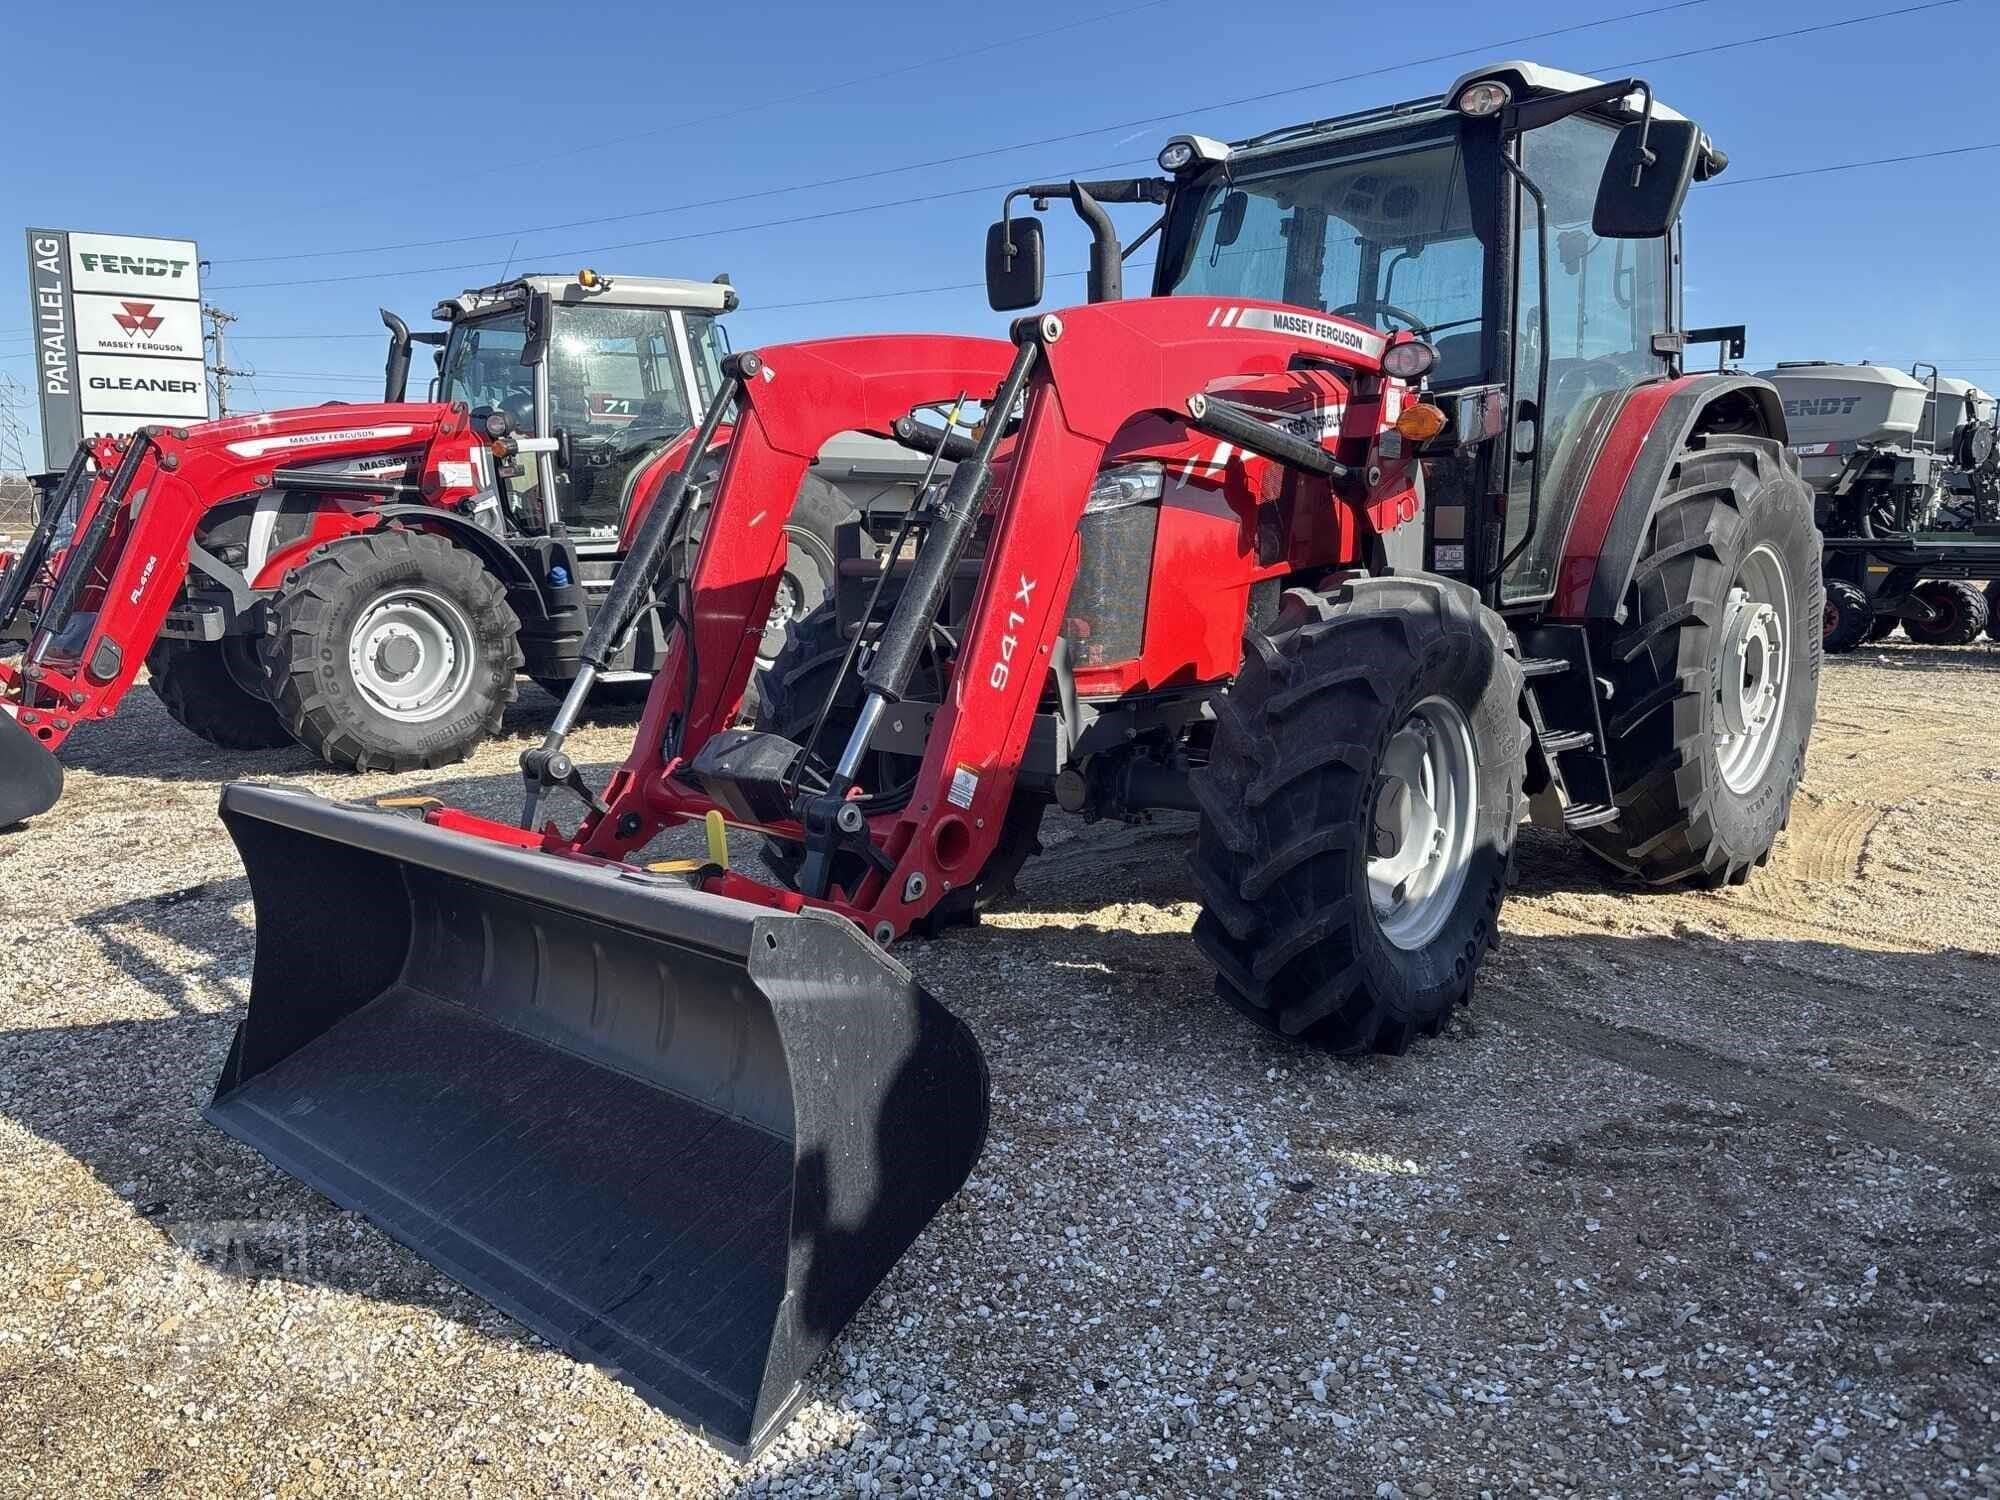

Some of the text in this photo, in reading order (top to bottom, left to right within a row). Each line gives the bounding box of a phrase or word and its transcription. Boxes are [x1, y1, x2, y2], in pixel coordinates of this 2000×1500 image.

[79, 253, 190, 278] FENDT
[34, 238, 70, 395] PARALLEL AG
[1273, 313, 1363, 350] MASSEY FERGUSON
[98, 339, 183, 352] MASSEY FERGUSON
[89, 377, 198, 394] GLEANER
[1783, 396, 1862, 416] ENDT
[1312, 413, 1343, 432] FERGUS
[289, 430, 375, 444] MASSEY FERGUSON
[358, 456, 408, 472] MASSEY
